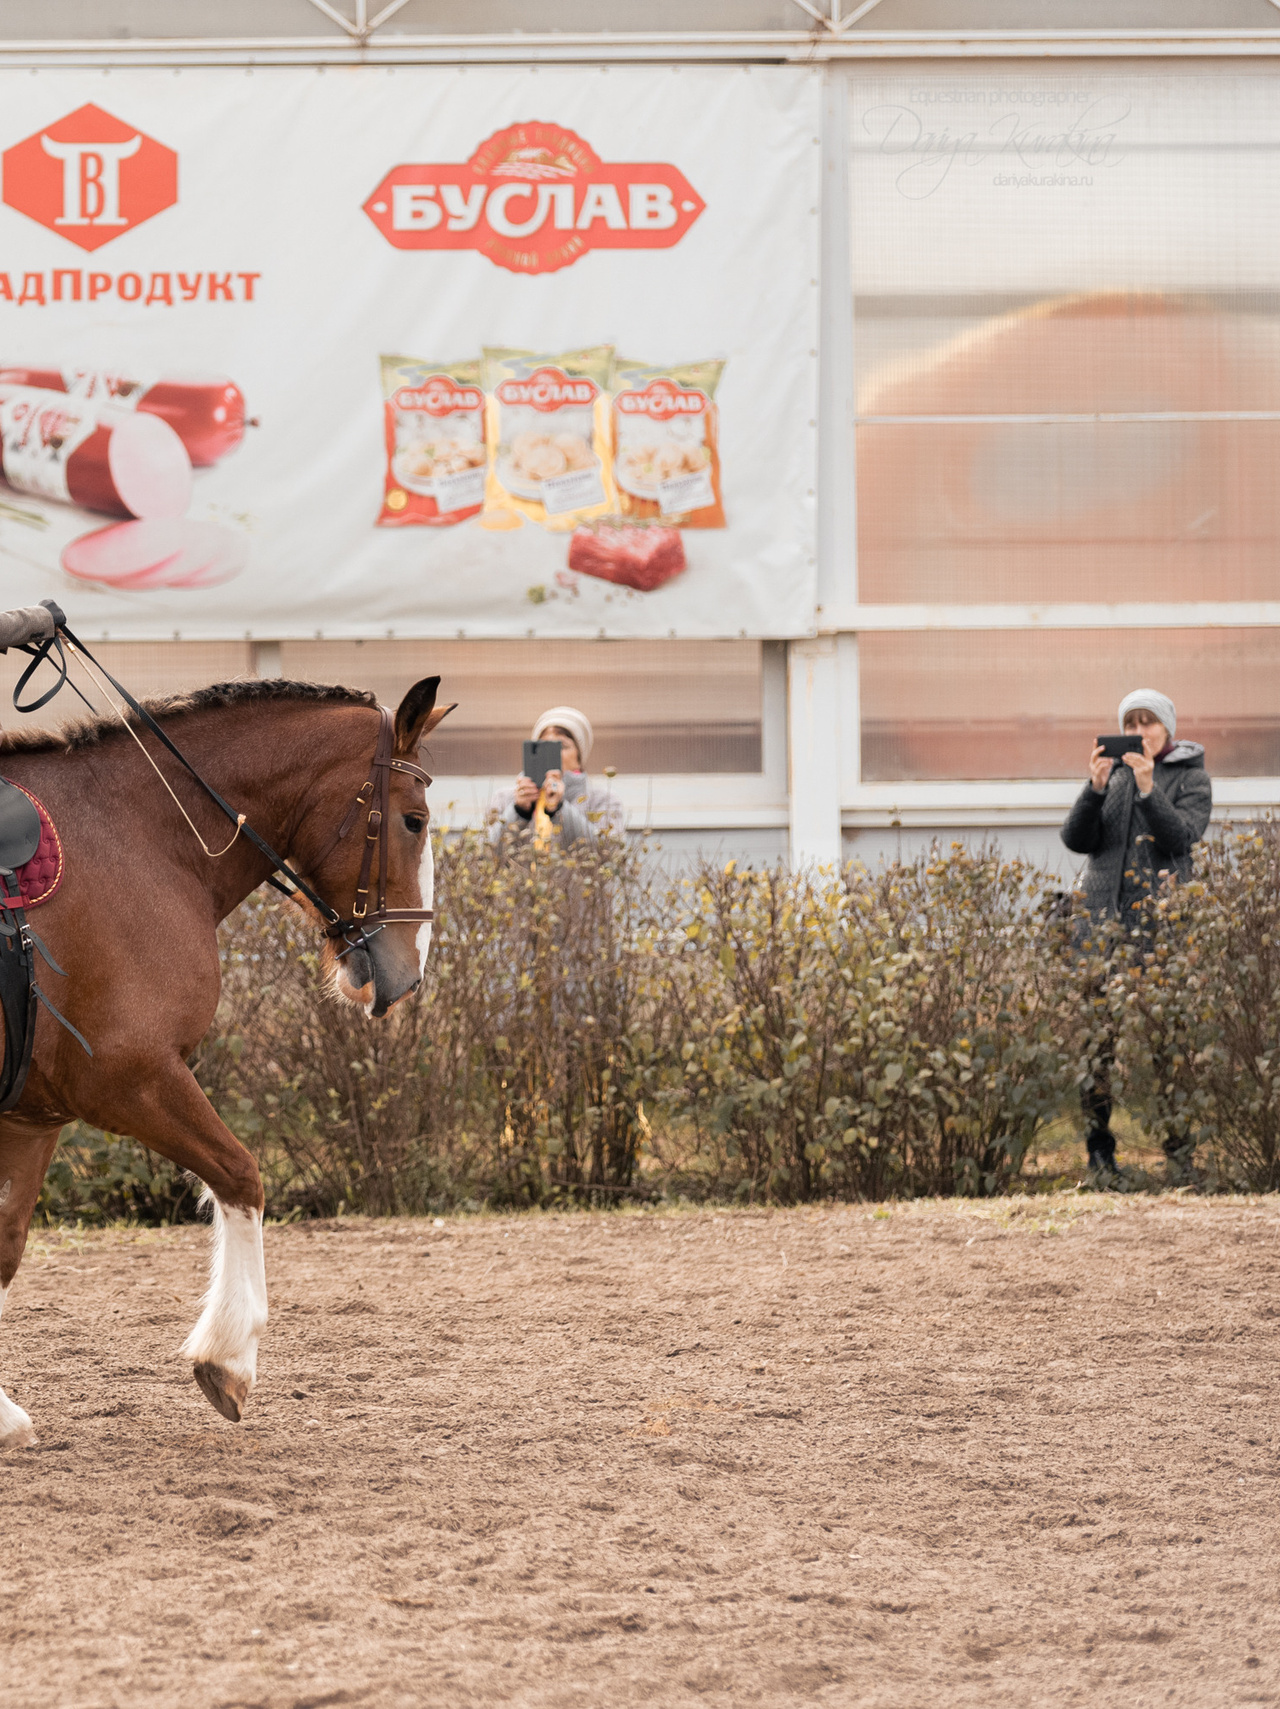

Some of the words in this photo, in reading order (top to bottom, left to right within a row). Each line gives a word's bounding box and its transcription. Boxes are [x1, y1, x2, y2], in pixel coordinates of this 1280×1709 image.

[391, 182, 679, 238] БУСЛАВ
[398, 389, 480, 409] БУСЛАВ
[502, 382, 592, 406] БУСЛАВ
[620, 392, 702, 413] БУСЛАВ
